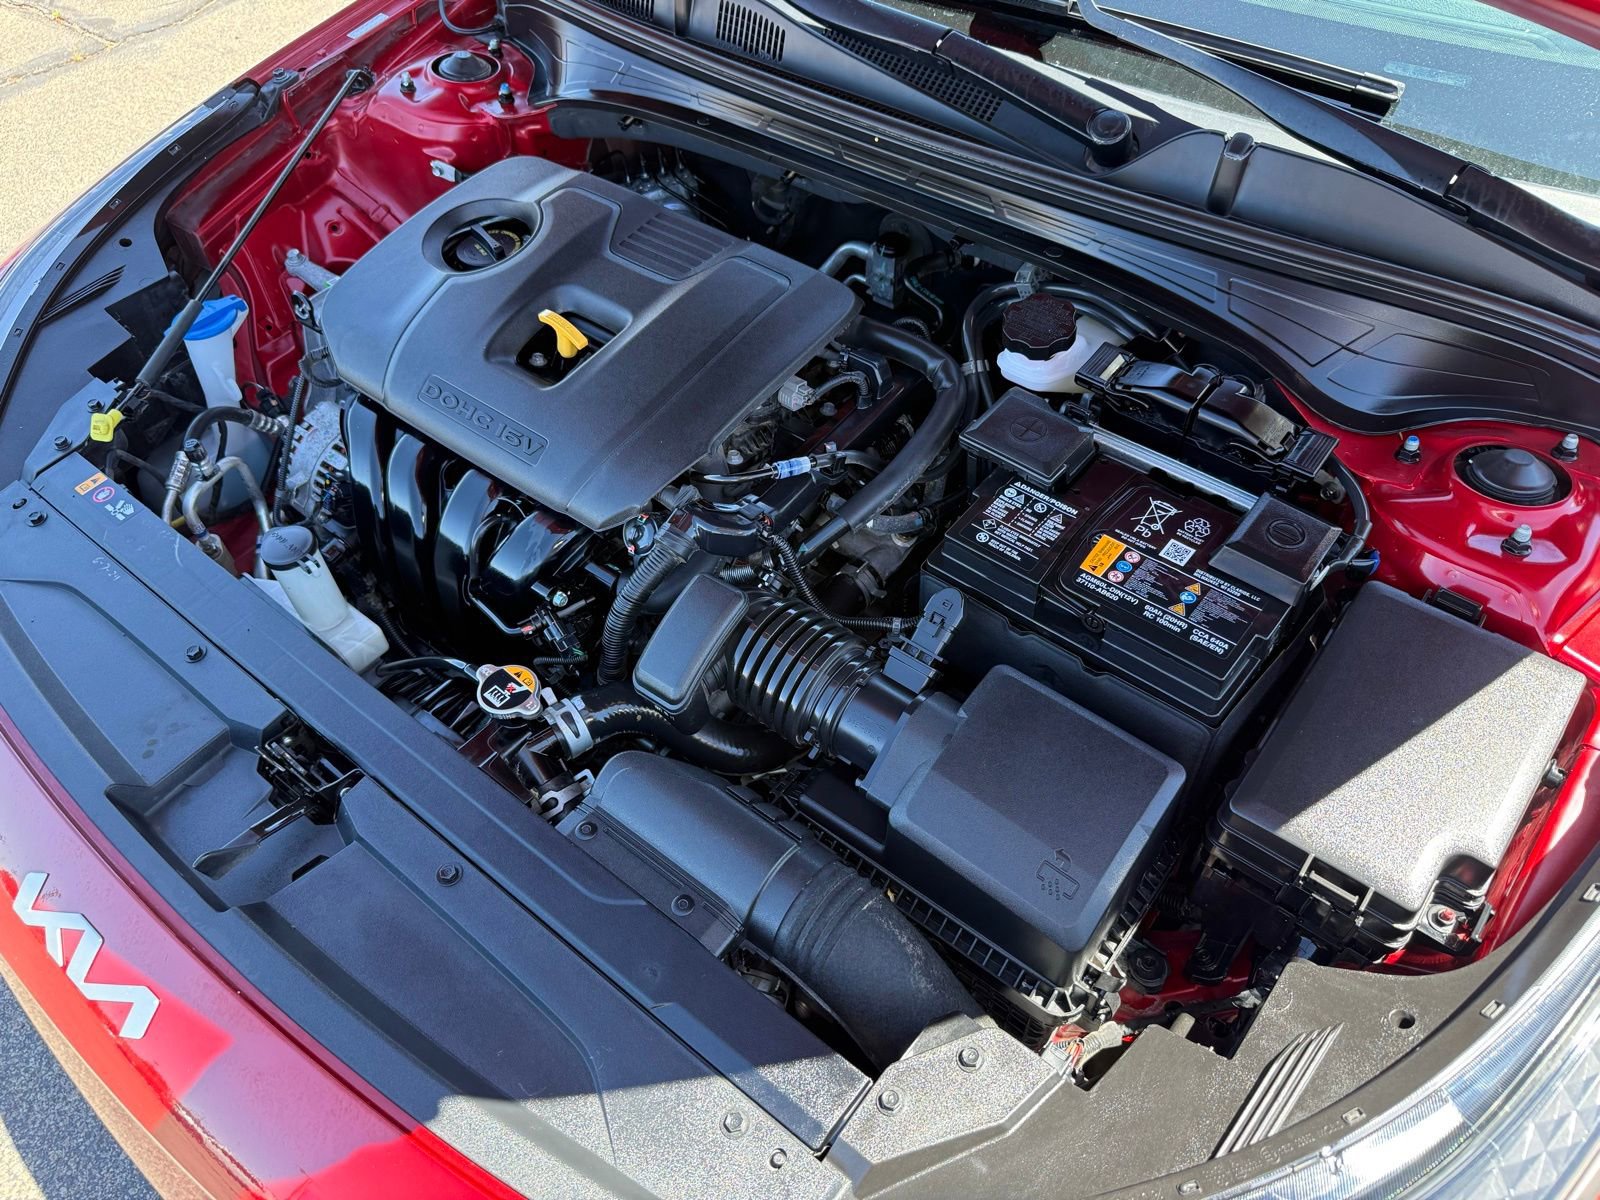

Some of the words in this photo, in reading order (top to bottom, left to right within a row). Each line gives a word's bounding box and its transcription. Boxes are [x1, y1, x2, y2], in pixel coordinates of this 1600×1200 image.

[422, 383, 494, 430] DOHC
[1020, 483, 1078, 515] DANGER/POISON
[1133, 524, 1152, 538] Pb
[1076, 578, 1120, 602] 37110-AB620
[1080, 573, 1138, 606] AGM60L-DIN(12V)
[1142, 610, 1154, 620] RC
[1156, 616, 1180, 632] 100min
[1144, 604, 1162, 618] 60Ah
[1162, 613, 1188, 630] (20HR)
[1190, 634, 1224, 655] (SAE/EN)
[1192, 628, 1210, 640] CCA
[1210, 636, 1228, 650] 640A
[12, 872, 160, 1039] KIA
